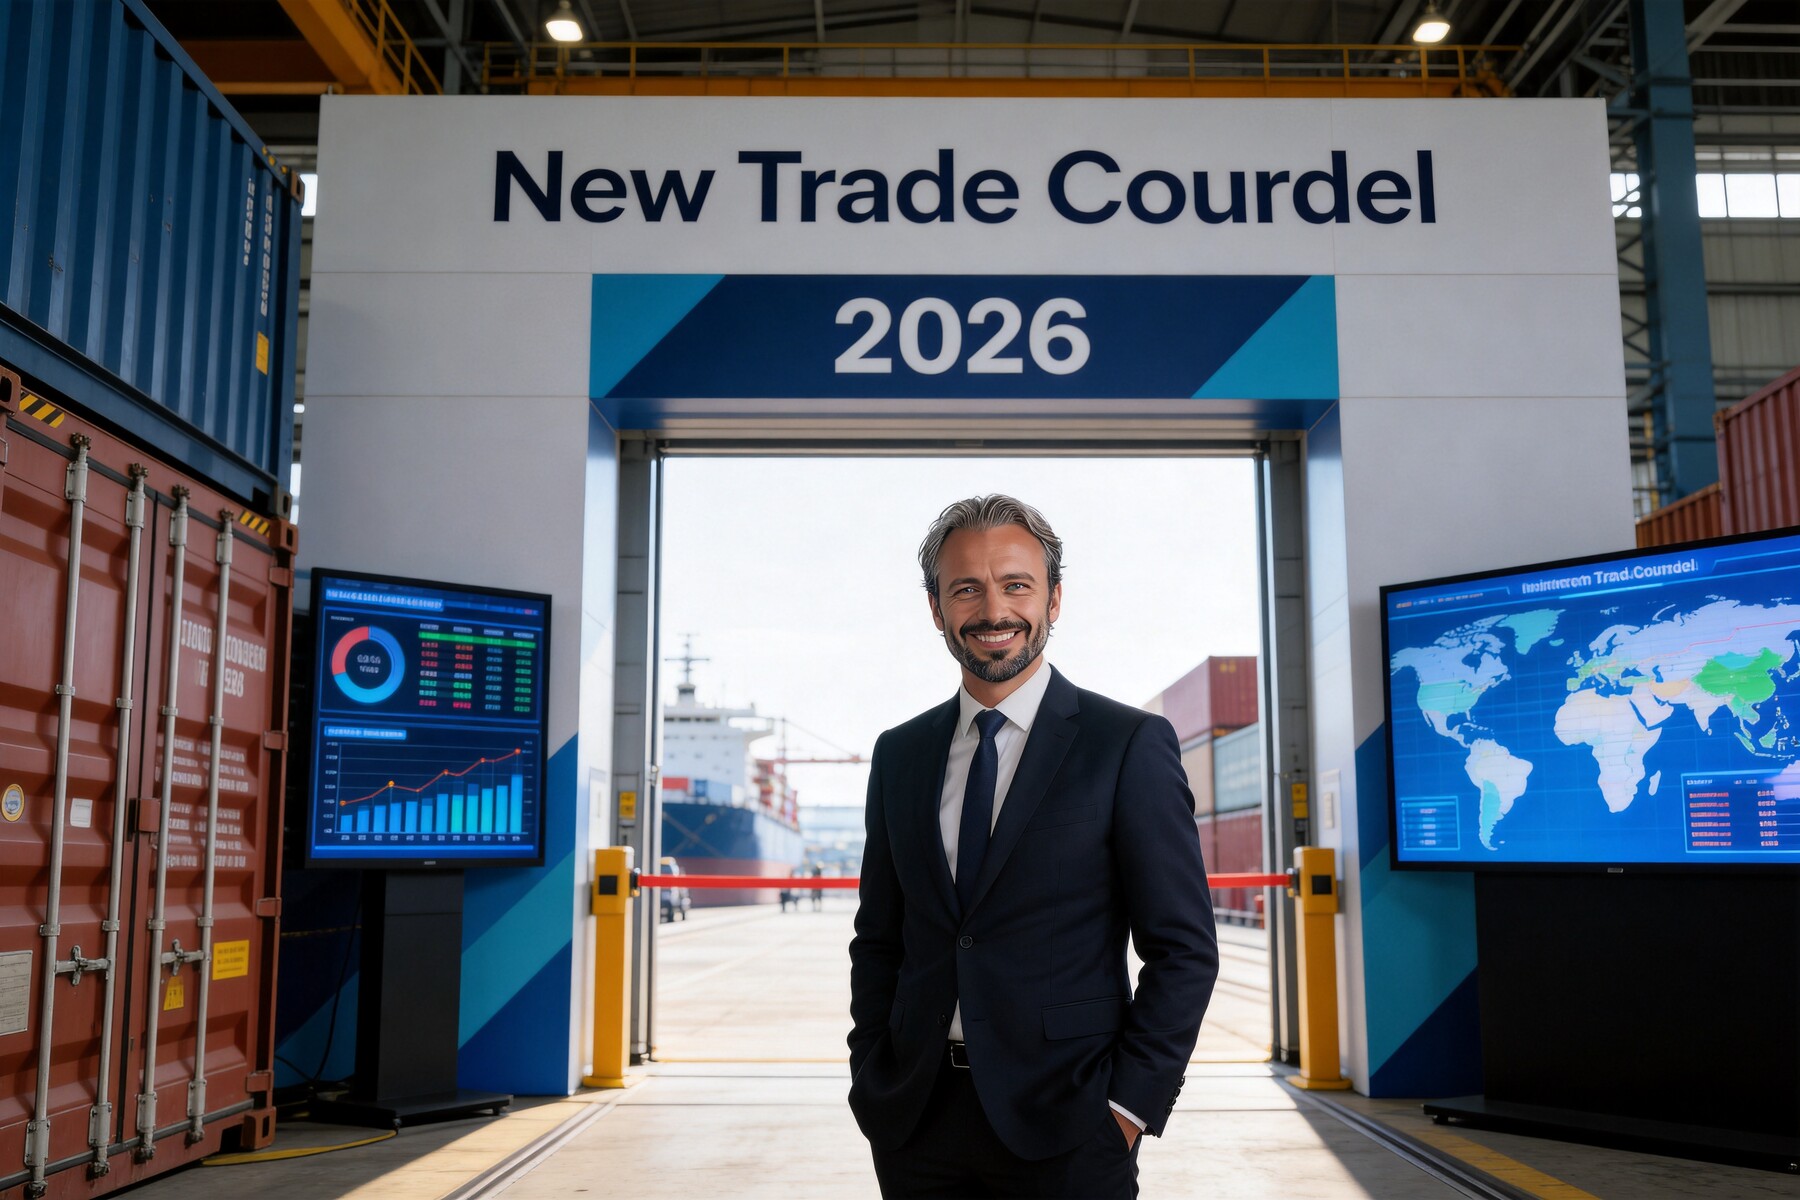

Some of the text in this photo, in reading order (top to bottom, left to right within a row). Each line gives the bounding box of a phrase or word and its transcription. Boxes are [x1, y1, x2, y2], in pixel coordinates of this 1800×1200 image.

[493, 149, 1437, 225] New Trade Courdel
[834, 297, 1091, 375] 2026
